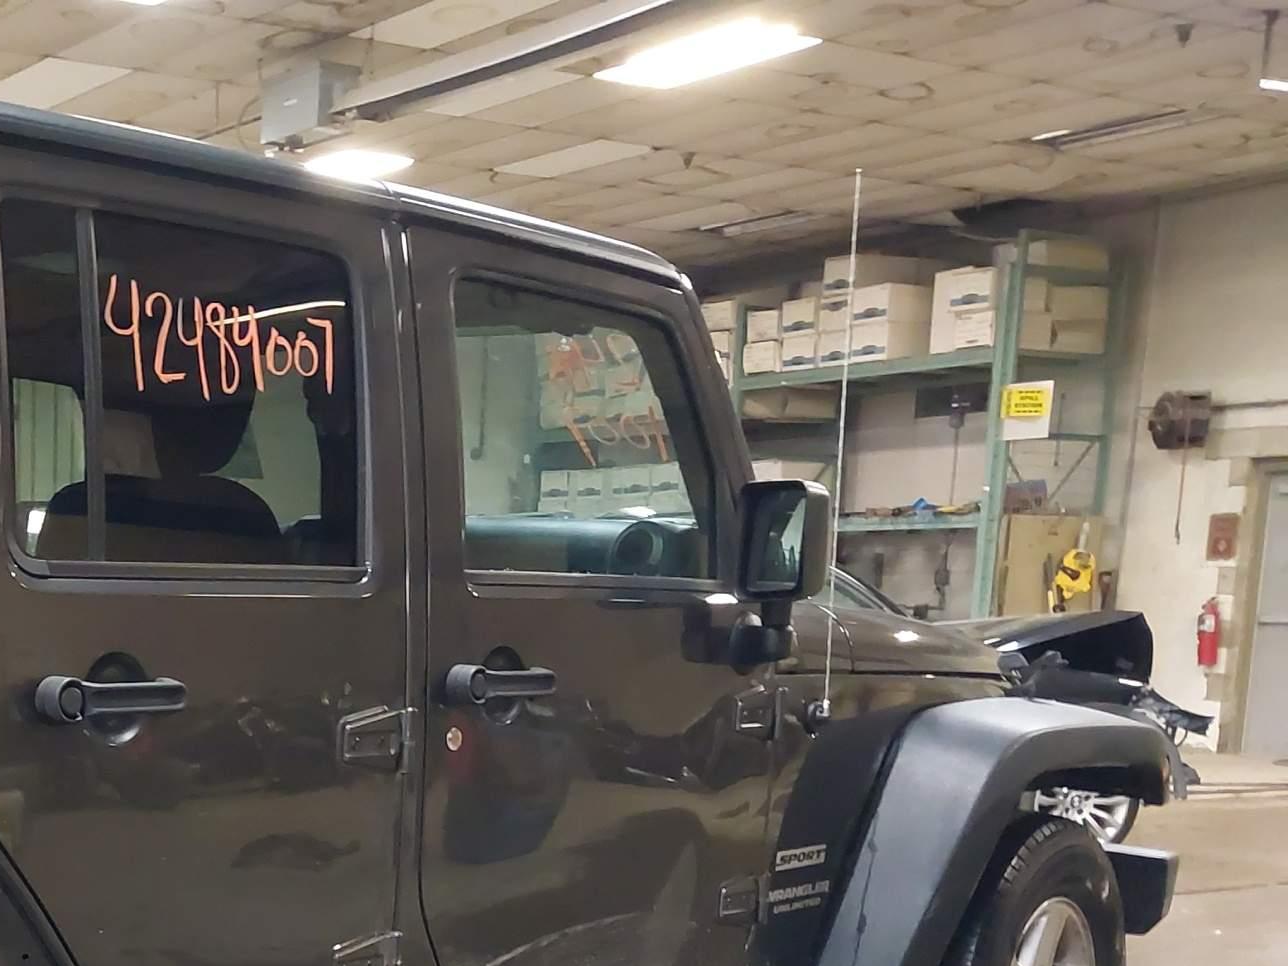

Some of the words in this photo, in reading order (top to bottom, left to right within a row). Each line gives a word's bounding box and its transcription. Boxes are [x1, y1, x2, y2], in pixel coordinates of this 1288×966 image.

[104, 274, 335, 401] 42484007
[779, 849, 825, 865] SPORT
[767, 880, 830, 903] WRANGLER
